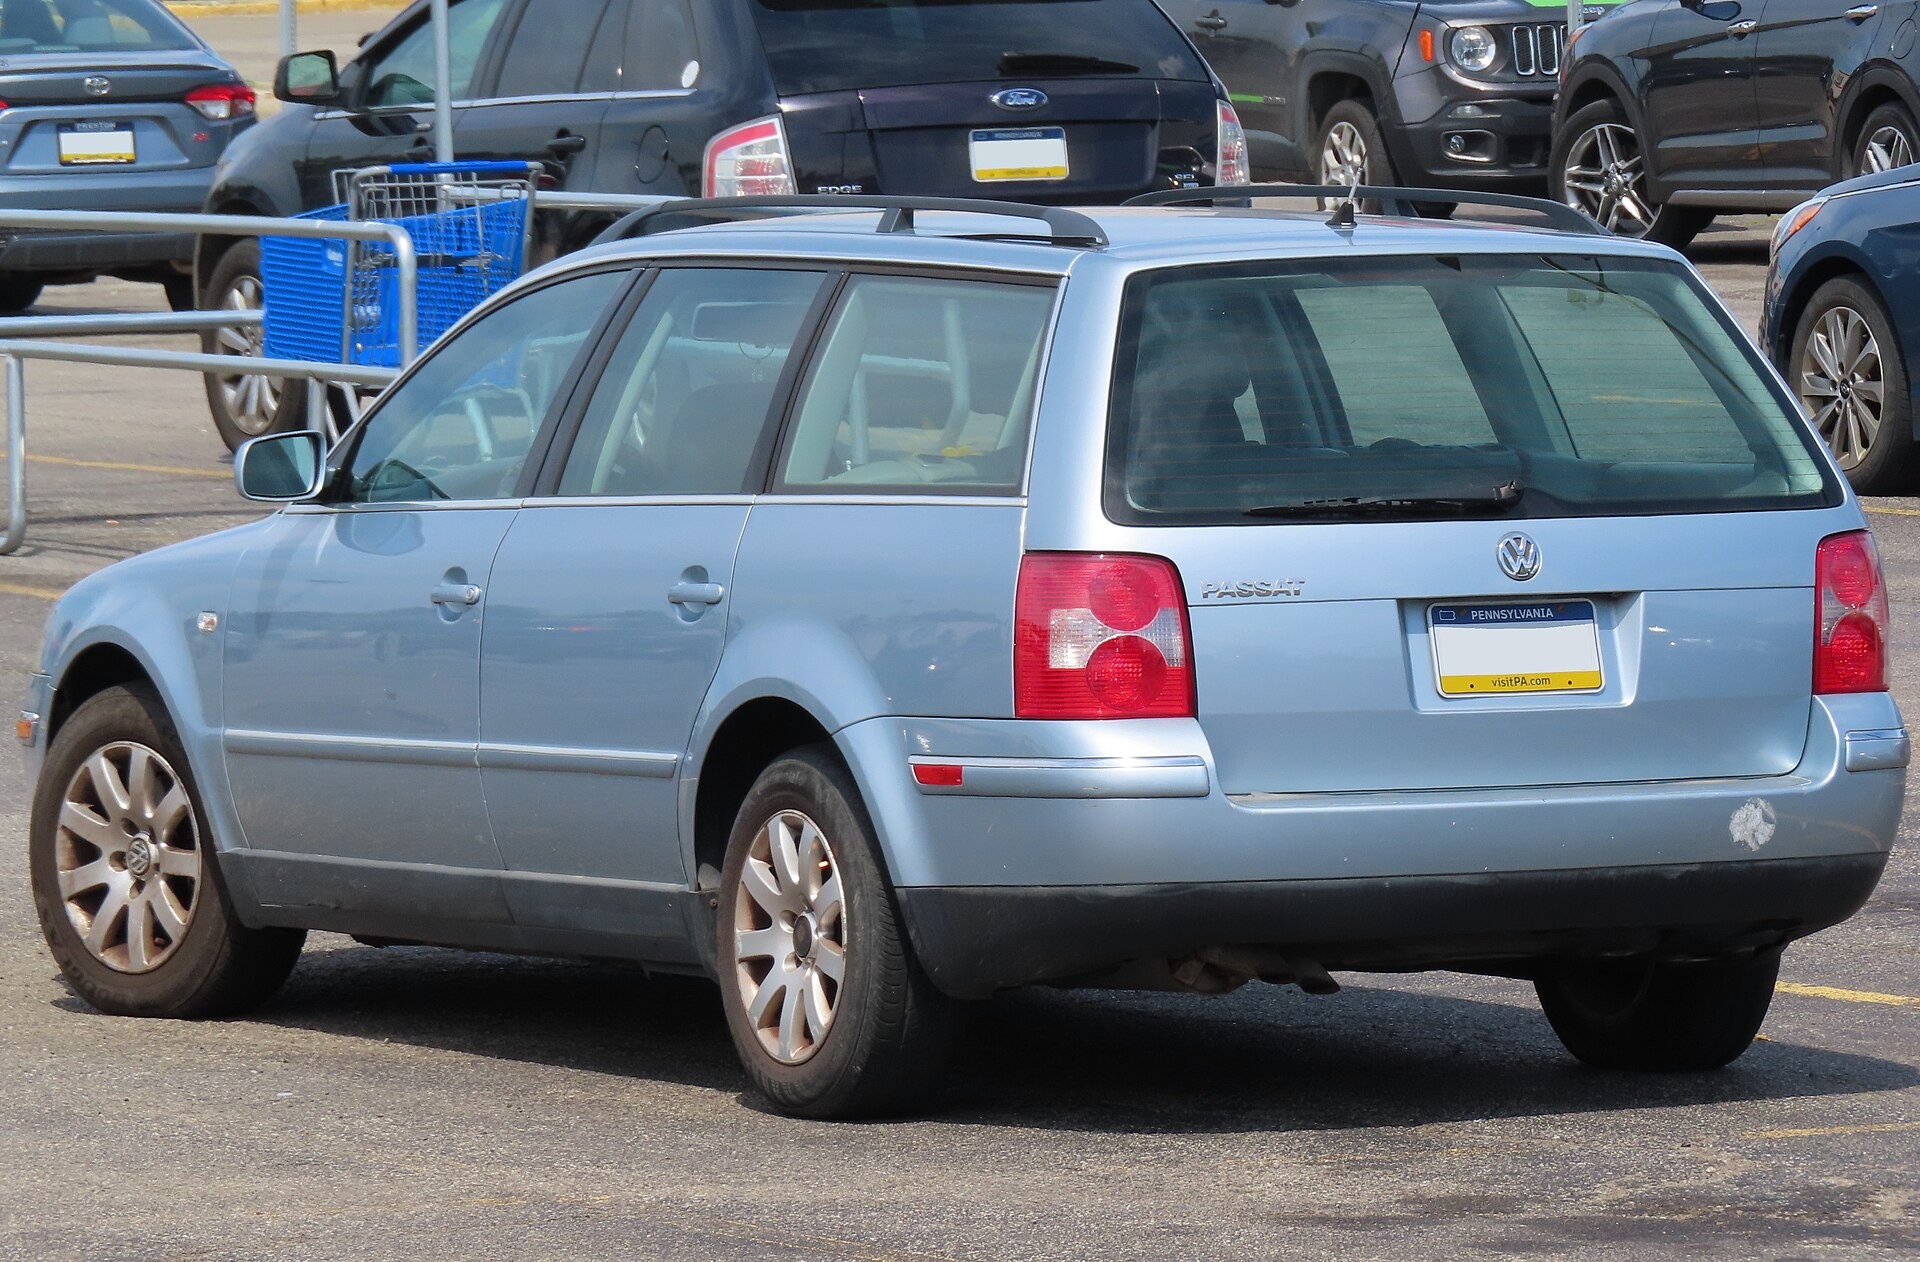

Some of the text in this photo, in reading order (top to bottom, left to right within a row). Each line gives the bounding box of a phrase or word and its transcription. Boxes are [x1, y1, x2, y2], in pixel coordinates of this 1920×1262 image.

[1005, 91, 1038, 106] Ford
[817, 185, 863, 195] EDGE
[1201, 578, 1305, 599] PASSAT
[1471, 608, 1554, 620] PENNSYLVANIA
[1491, 676, 1551, 688] visitPA.com
